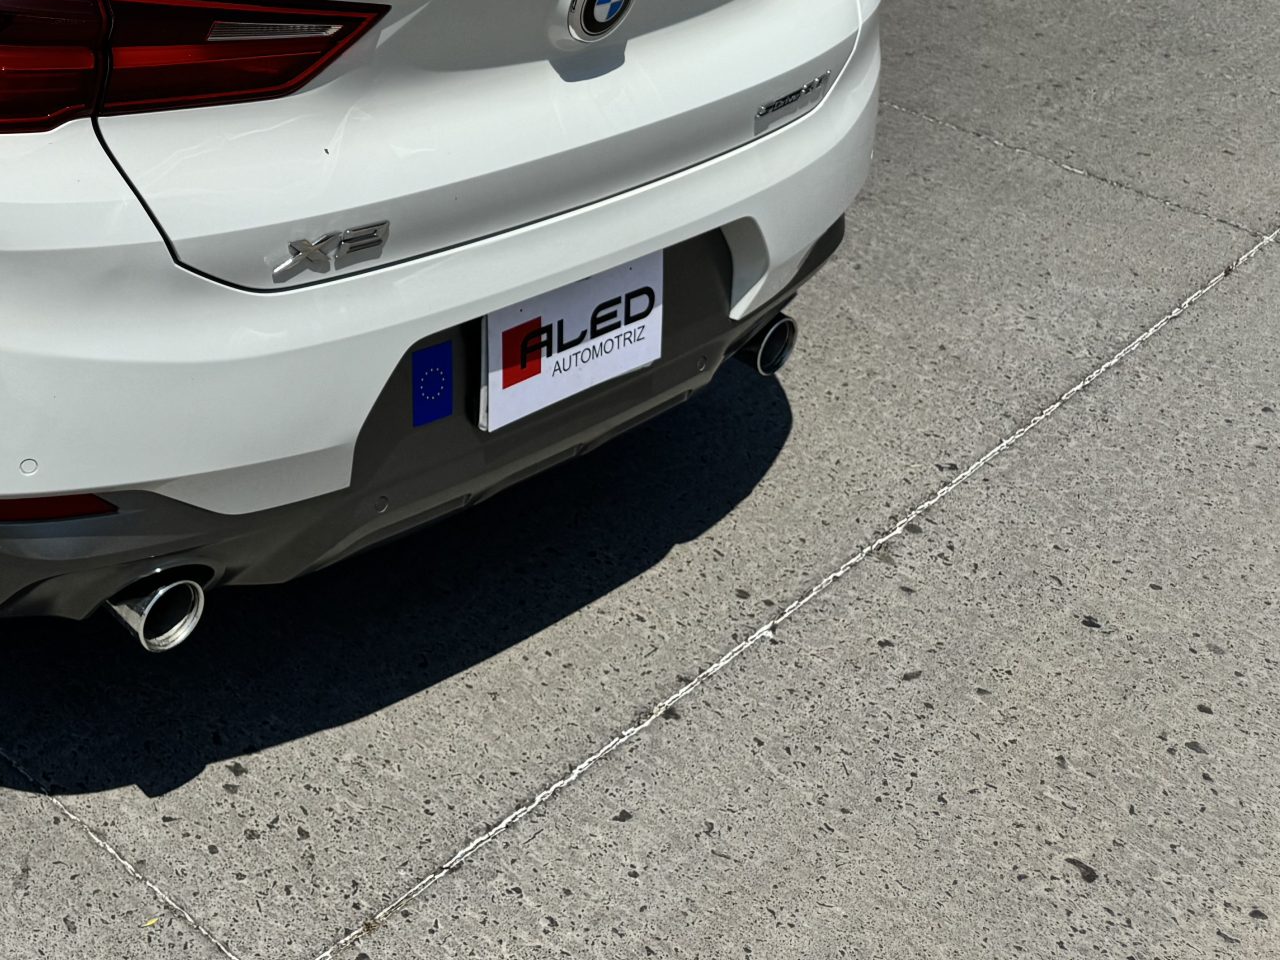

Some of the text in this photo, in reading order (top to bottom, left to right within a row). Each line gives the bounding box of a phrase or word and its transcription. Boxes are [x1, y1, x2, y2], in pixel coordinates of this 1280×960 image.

[272, 220, 390, 283] X2
[521, 286, 655, 369] ALED
[552, 325, 645, 377] AUTOMOTRIZ
